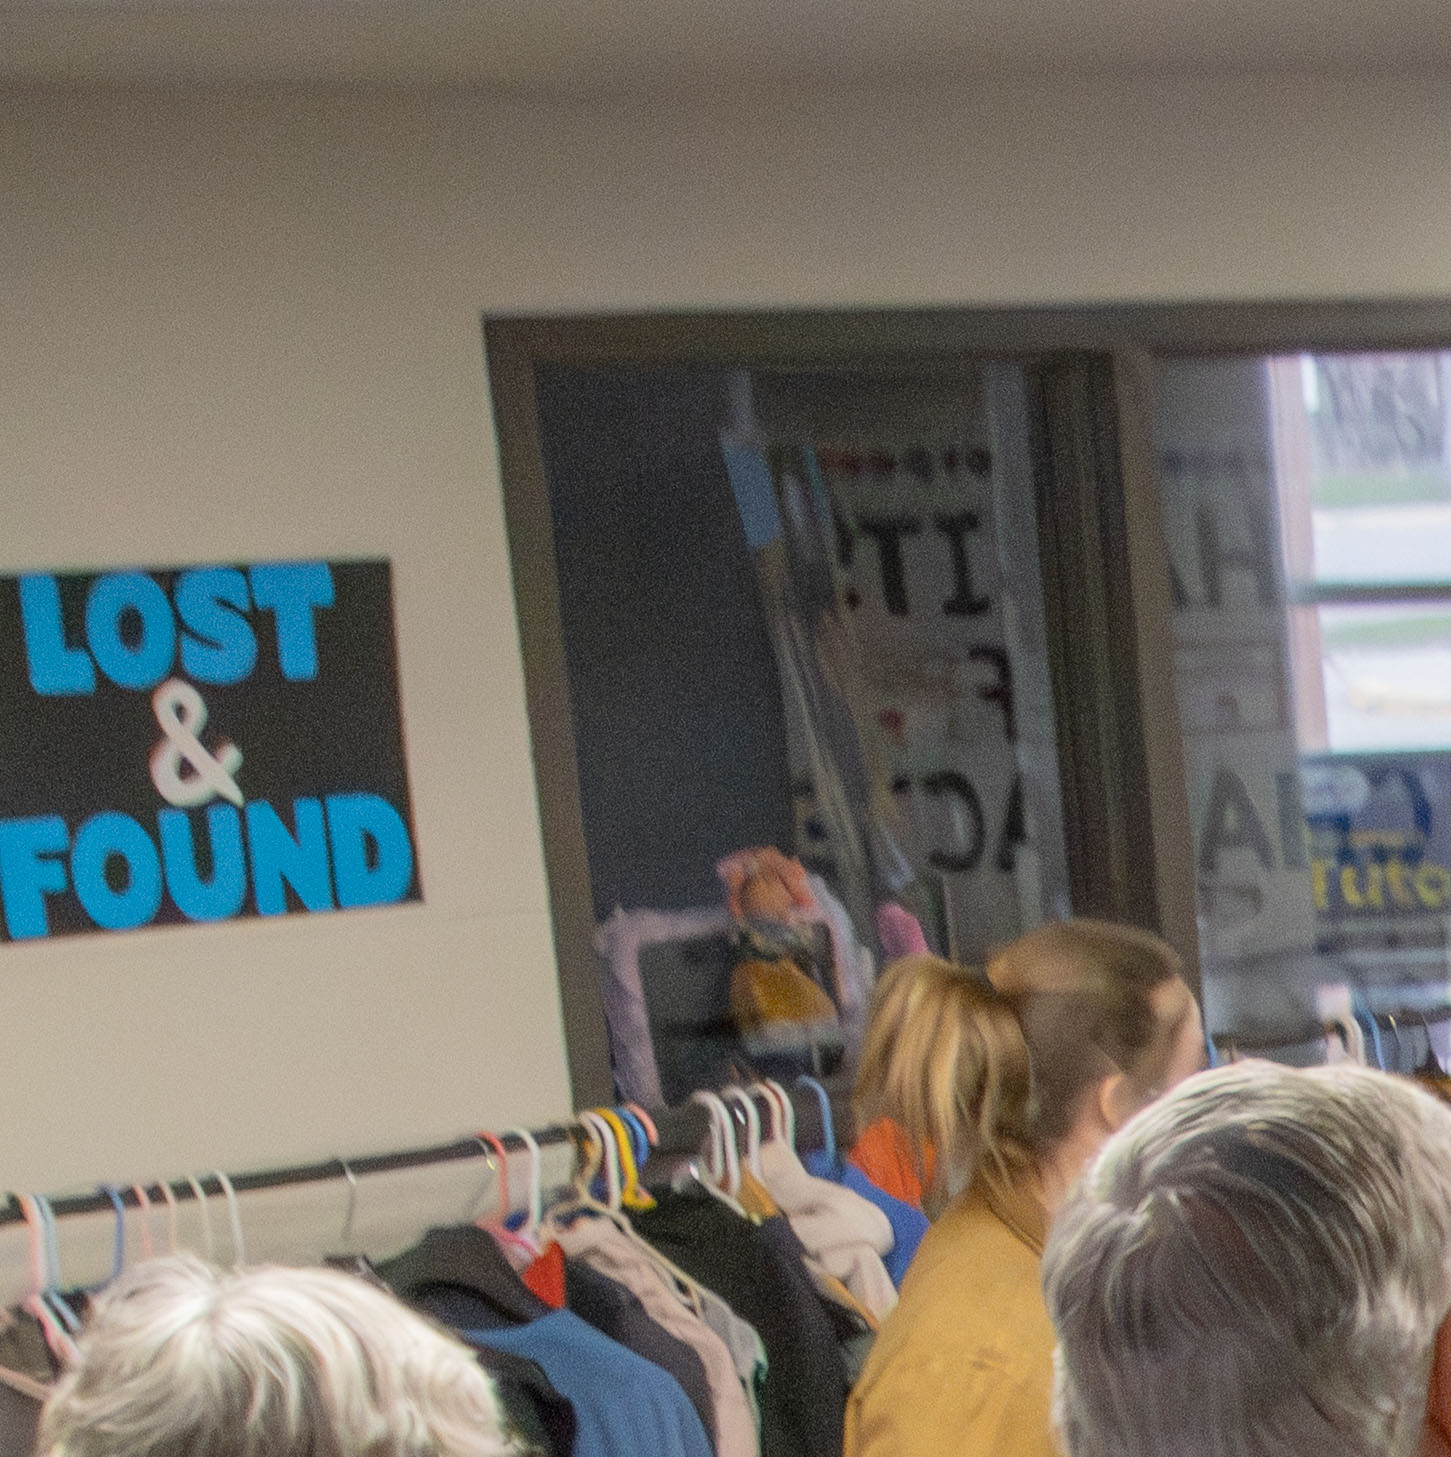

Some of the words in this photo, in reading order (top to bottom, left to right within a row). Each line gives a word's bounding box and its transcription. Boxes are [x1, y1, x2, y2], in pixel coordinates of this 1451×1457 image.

[17, 560, 337, 697] LOST
[149, 677, 246, 809] &
[0, 792, 415, 942] FOUND
